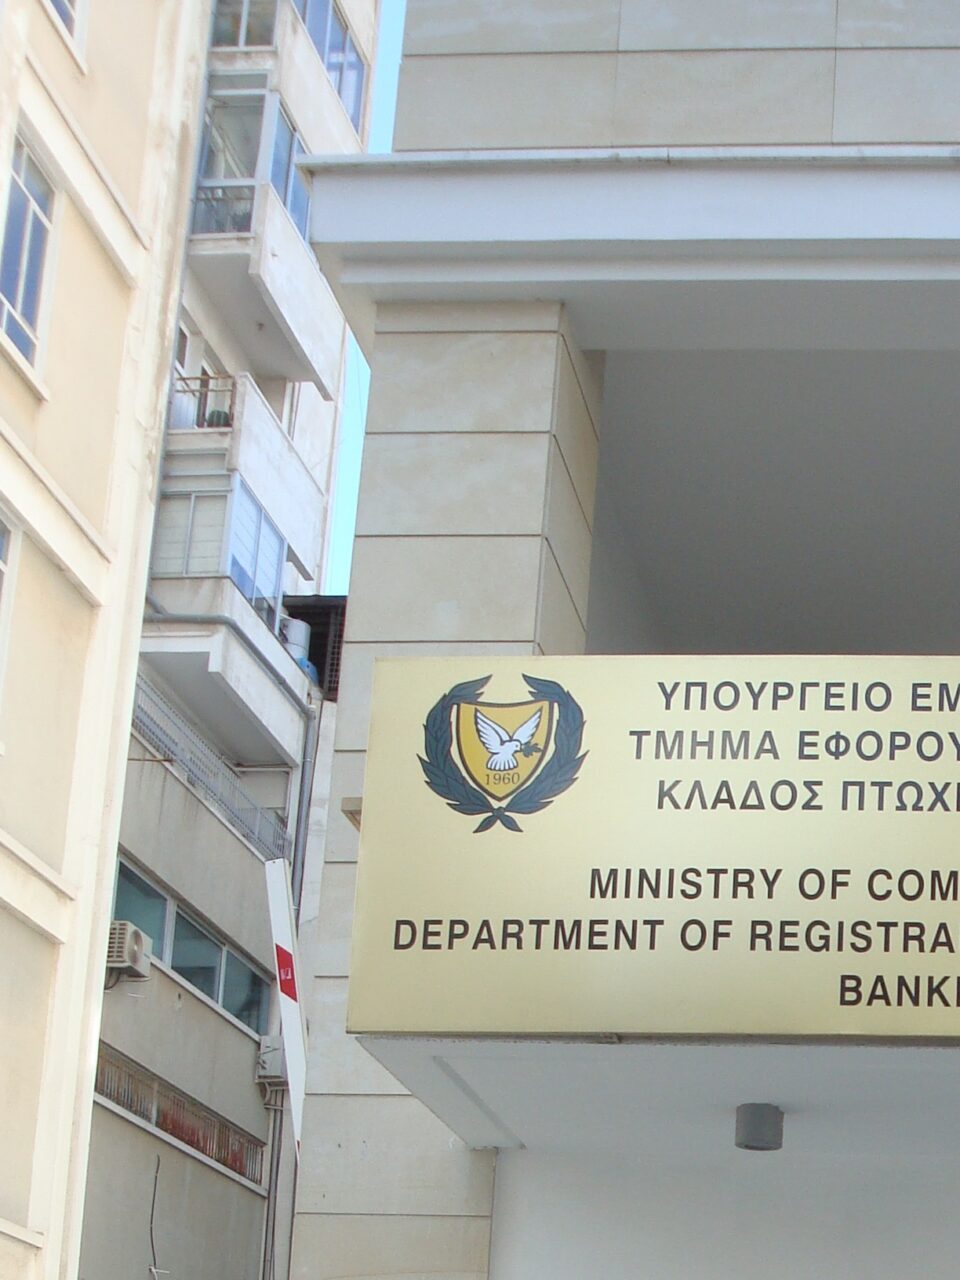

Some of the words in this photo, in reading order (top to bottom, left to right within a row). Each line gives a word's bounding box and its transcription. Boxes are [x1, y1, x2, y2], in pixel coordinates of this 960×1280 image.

[657, 680, 893, 713] ΥΠΟΥΡΓΕΙΟ
[628, 729, 780, 761] ΤΜΗΜΑ
[484, 772, 520, 786] 1960
[657, 778, 824, 812] ΚΛΑΔΟΣ
[589, 867, 783, 900] MINISTRY
[798, 867, 852, 901] OF
[393, 918, 665, 951] DEPARTMENT
[679, 918, 733, 952] OF
